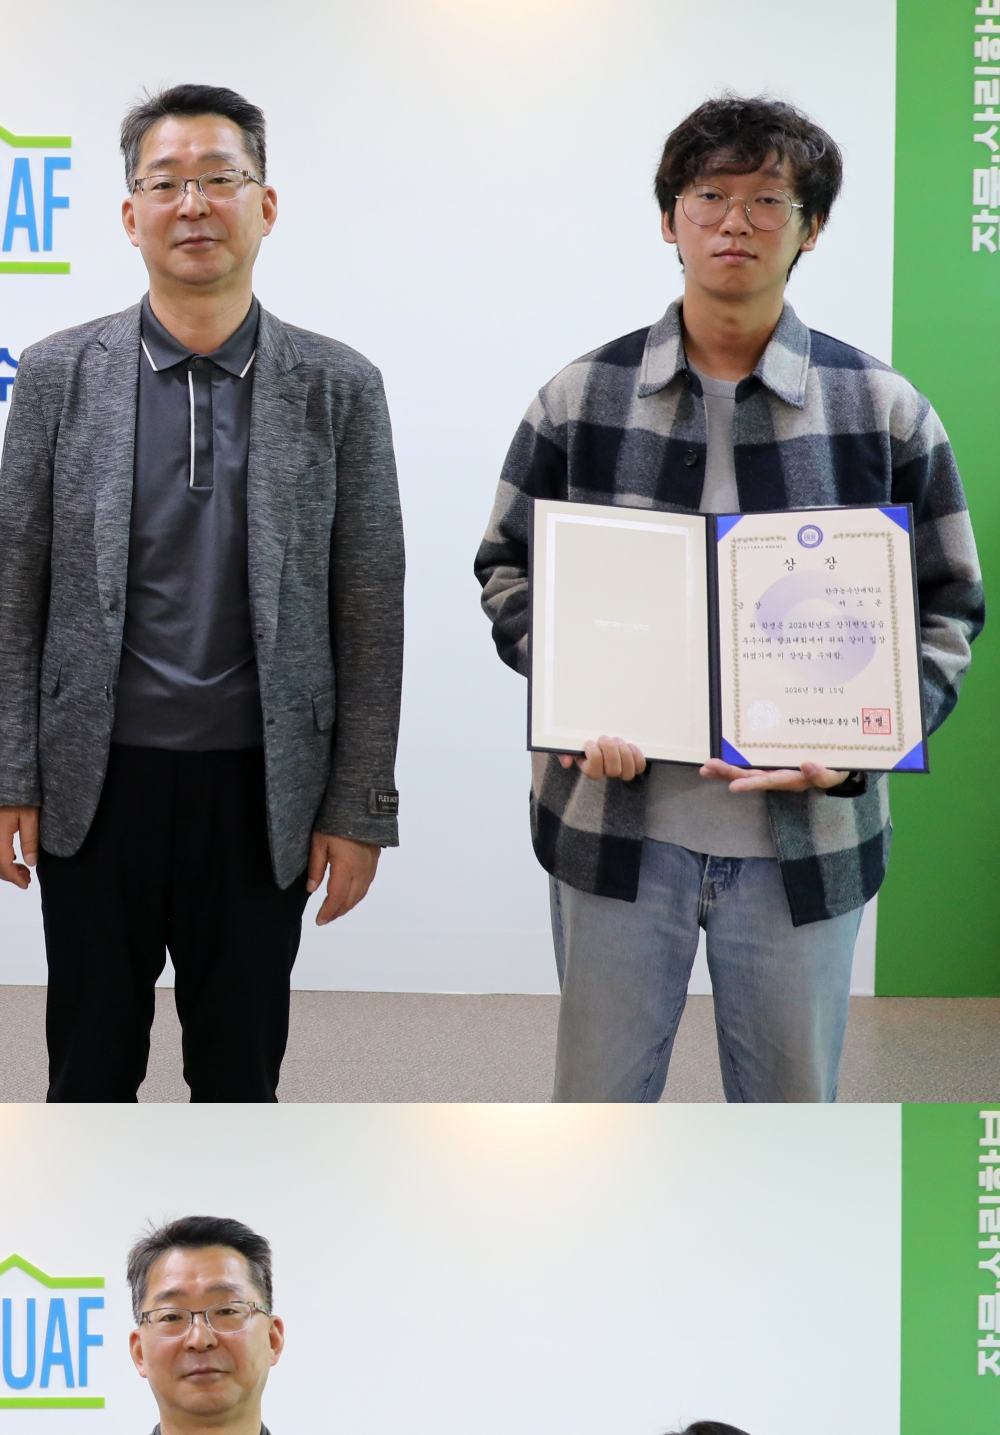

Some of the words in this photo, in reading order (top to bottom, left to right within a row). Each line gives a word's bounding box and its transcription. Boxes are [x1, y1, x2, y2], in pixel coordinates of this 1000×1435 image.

[783, 557, 796, 571] 상
[824, 556, 837, 570] 장
[788, 621, 831, 629] 2026학년도
